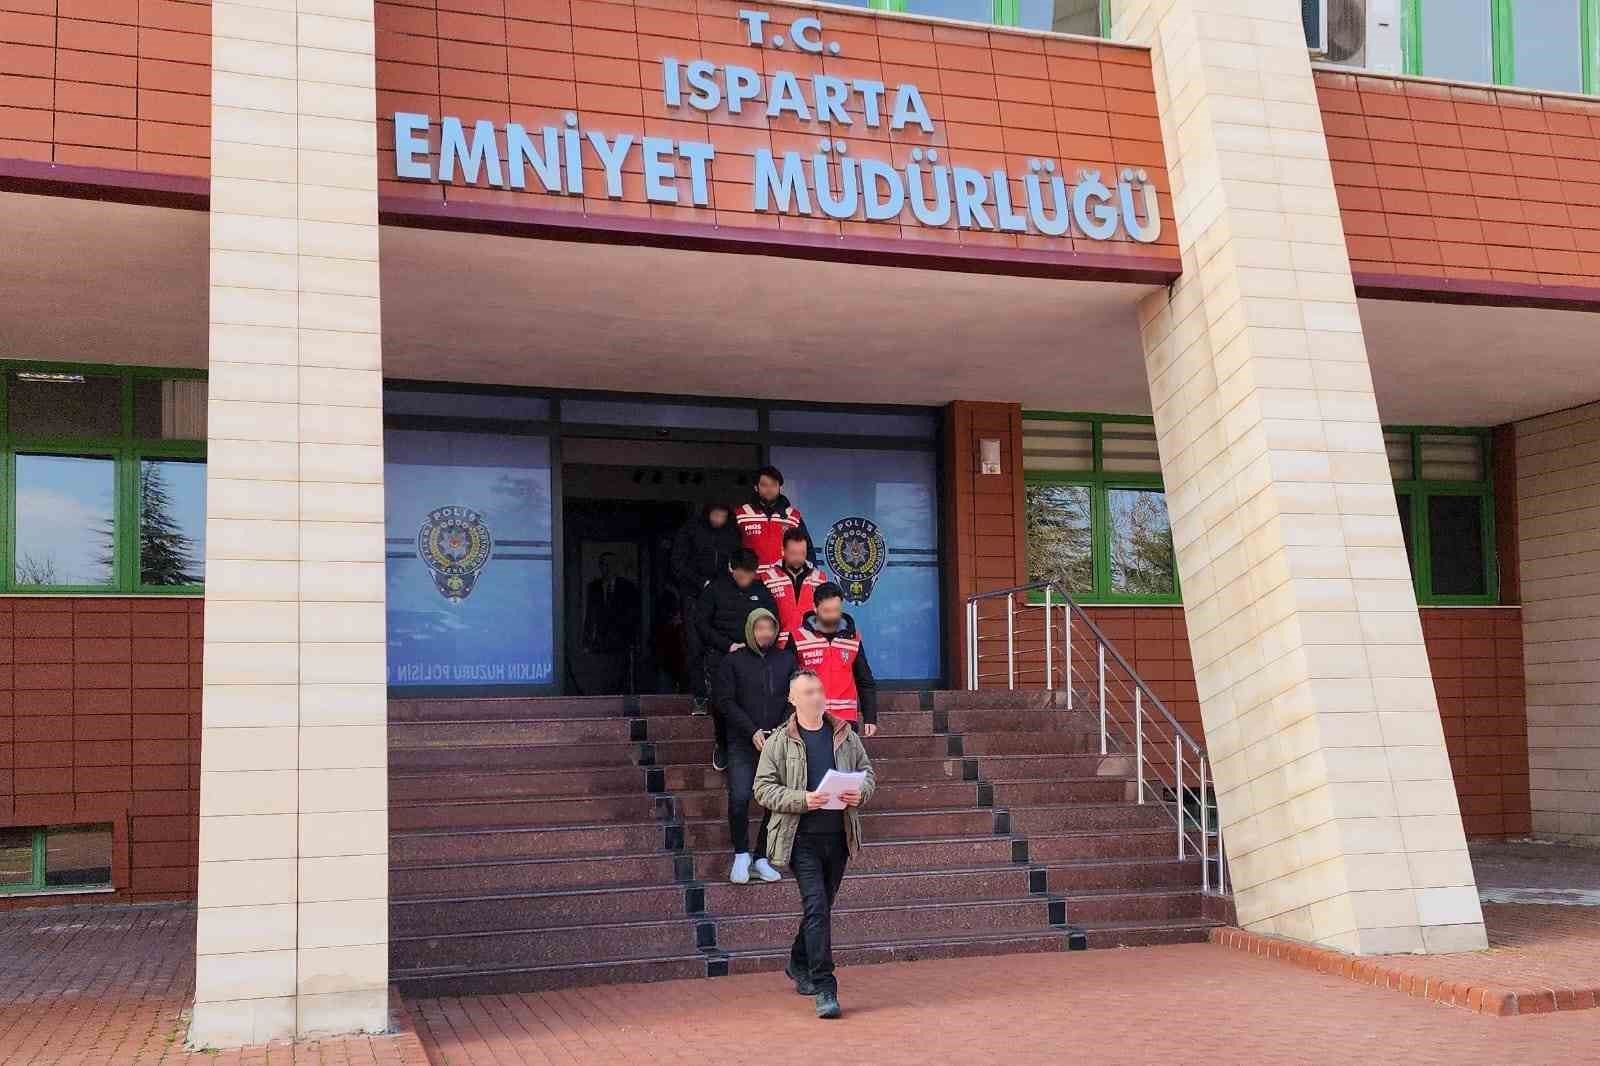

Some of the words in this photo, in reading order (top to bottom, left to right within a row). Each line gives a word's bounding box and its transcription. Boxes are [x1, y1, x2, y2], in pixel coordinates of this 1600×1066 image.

[739, 8, 840, 55] T.C.
[662, 56, 935, 135] ISPARTA
[394, 111, 715, 207] EMNİYET
[753, 138, 1162, 244] MÜDÜRLÜĞÜ
